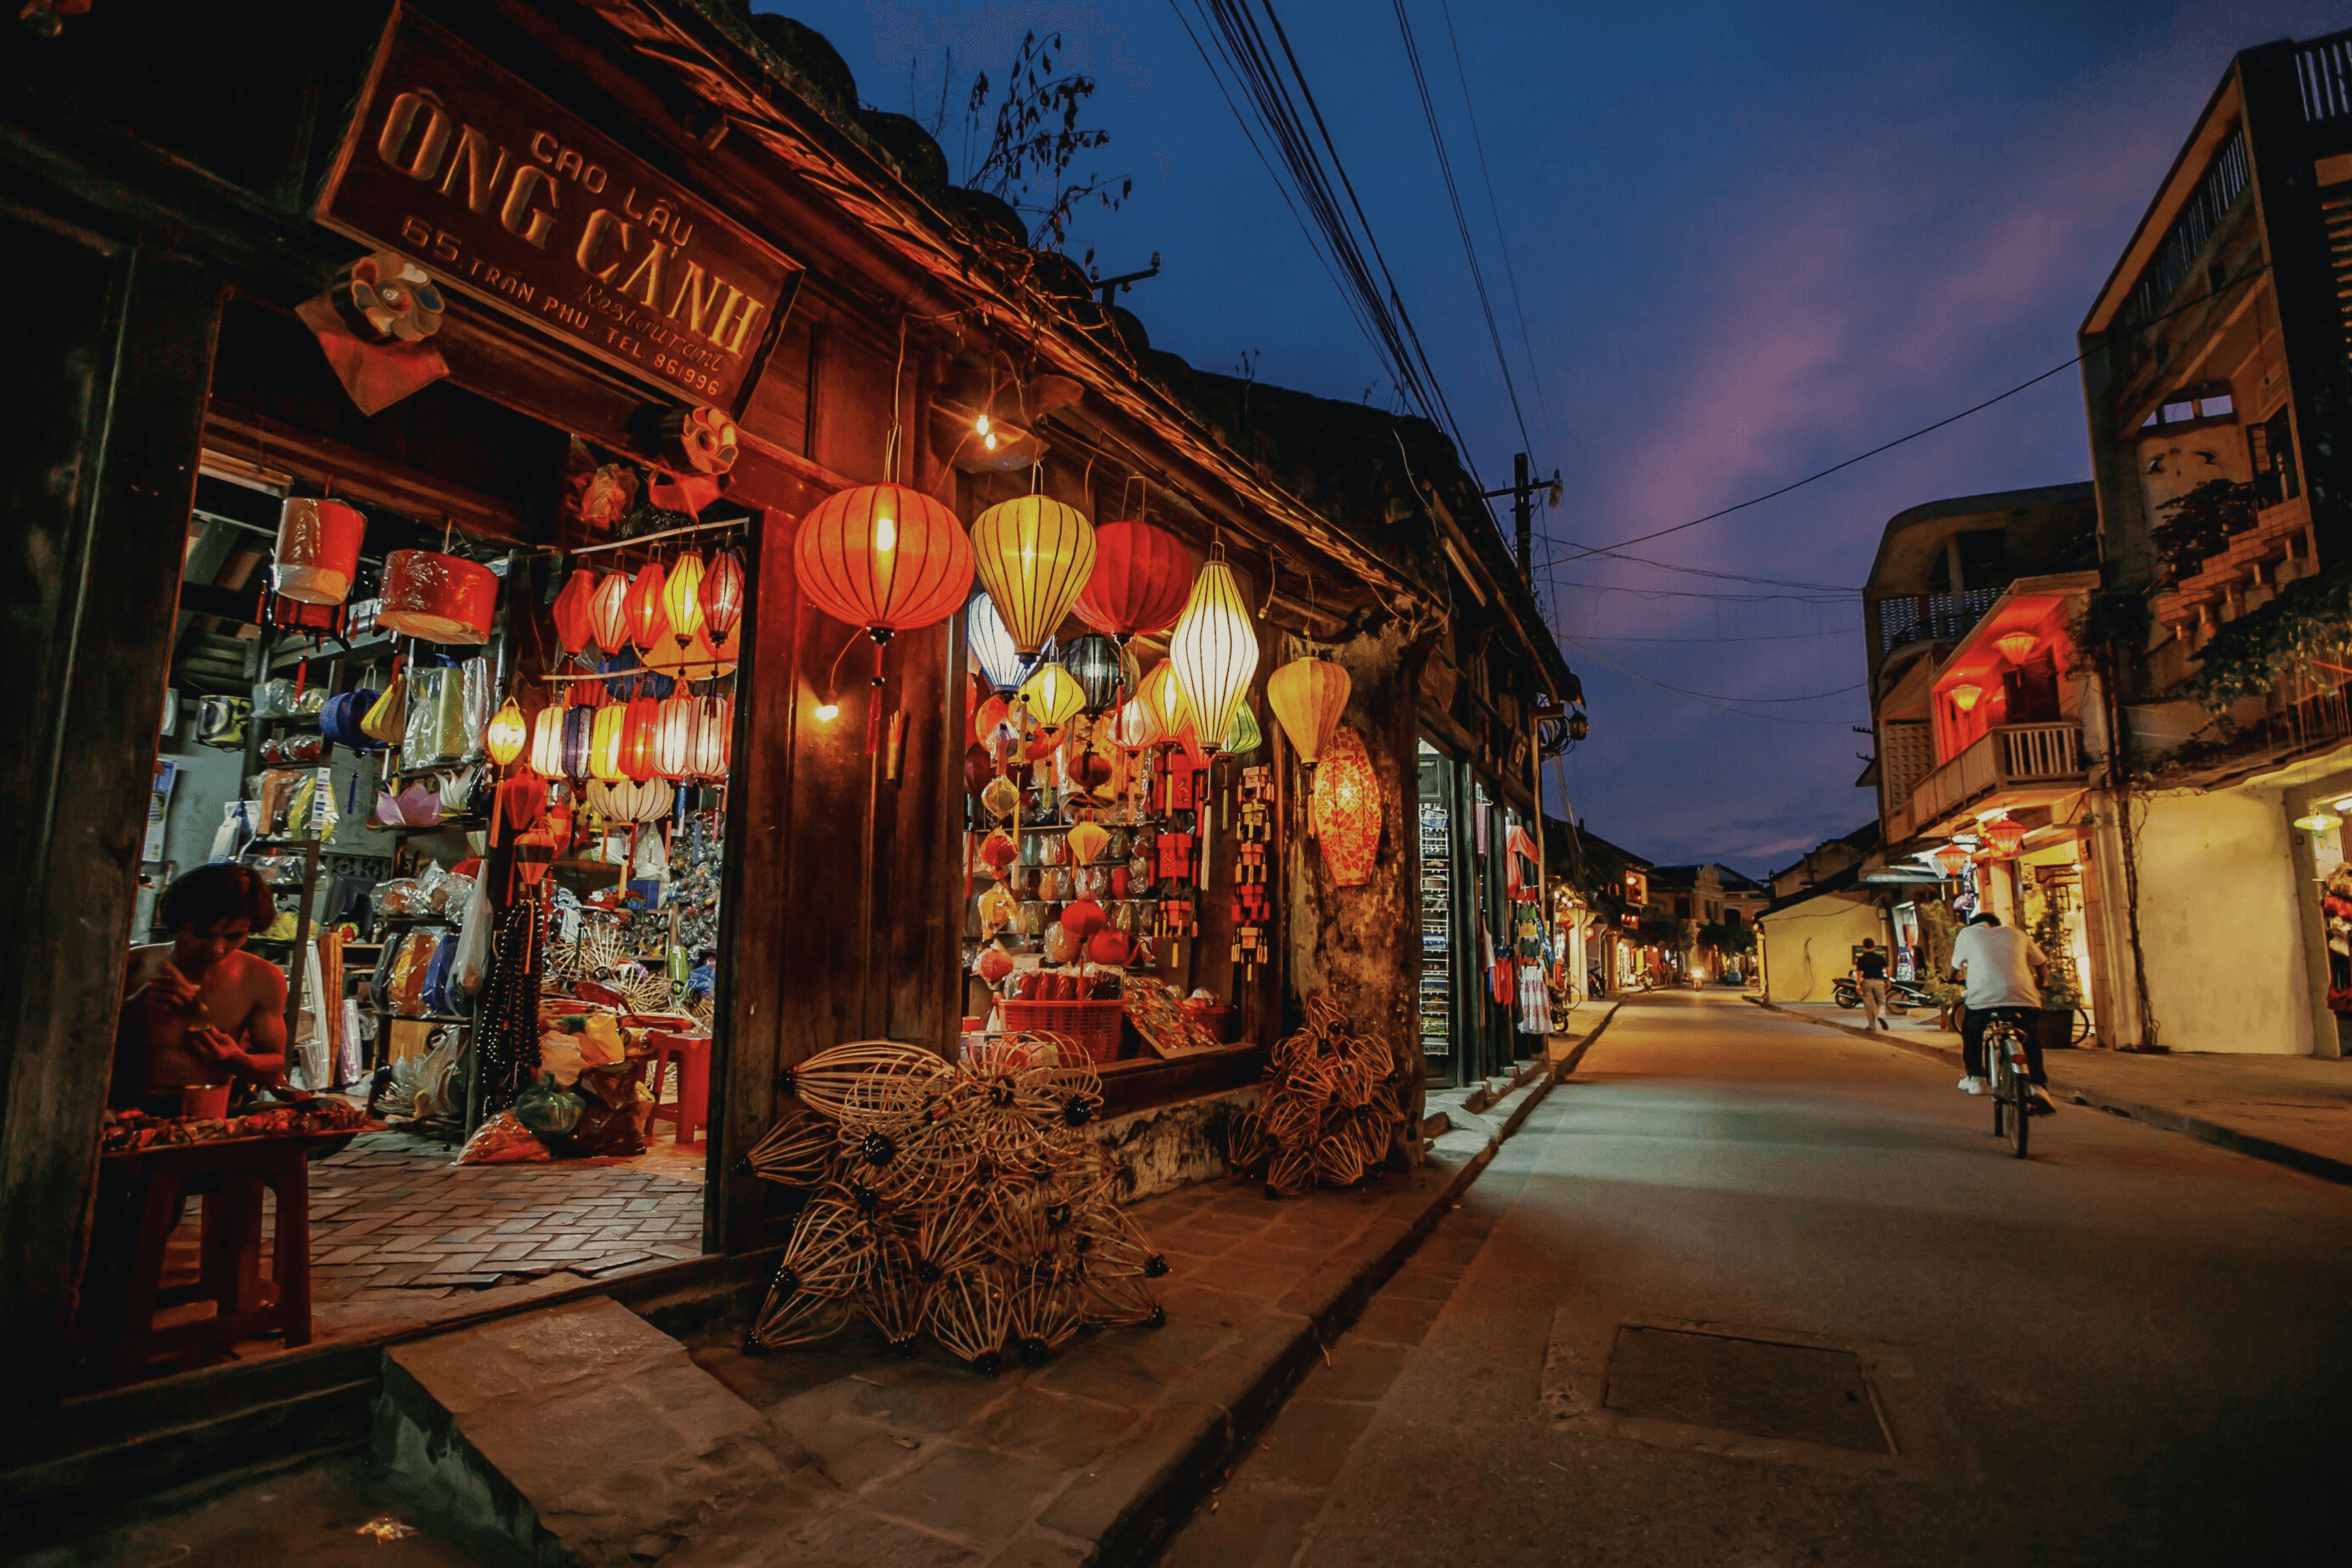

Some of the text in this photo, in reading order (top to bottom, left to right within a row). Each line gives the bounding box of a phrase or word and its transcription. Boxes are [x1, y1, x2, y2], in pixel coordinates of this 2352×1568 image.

[378, 87, 559, 250] ÔNG
[530, 131, 607, 194] CAO
[579, 284, 723, 371] Restaurant
[654, 353, 719, 395] 861996
